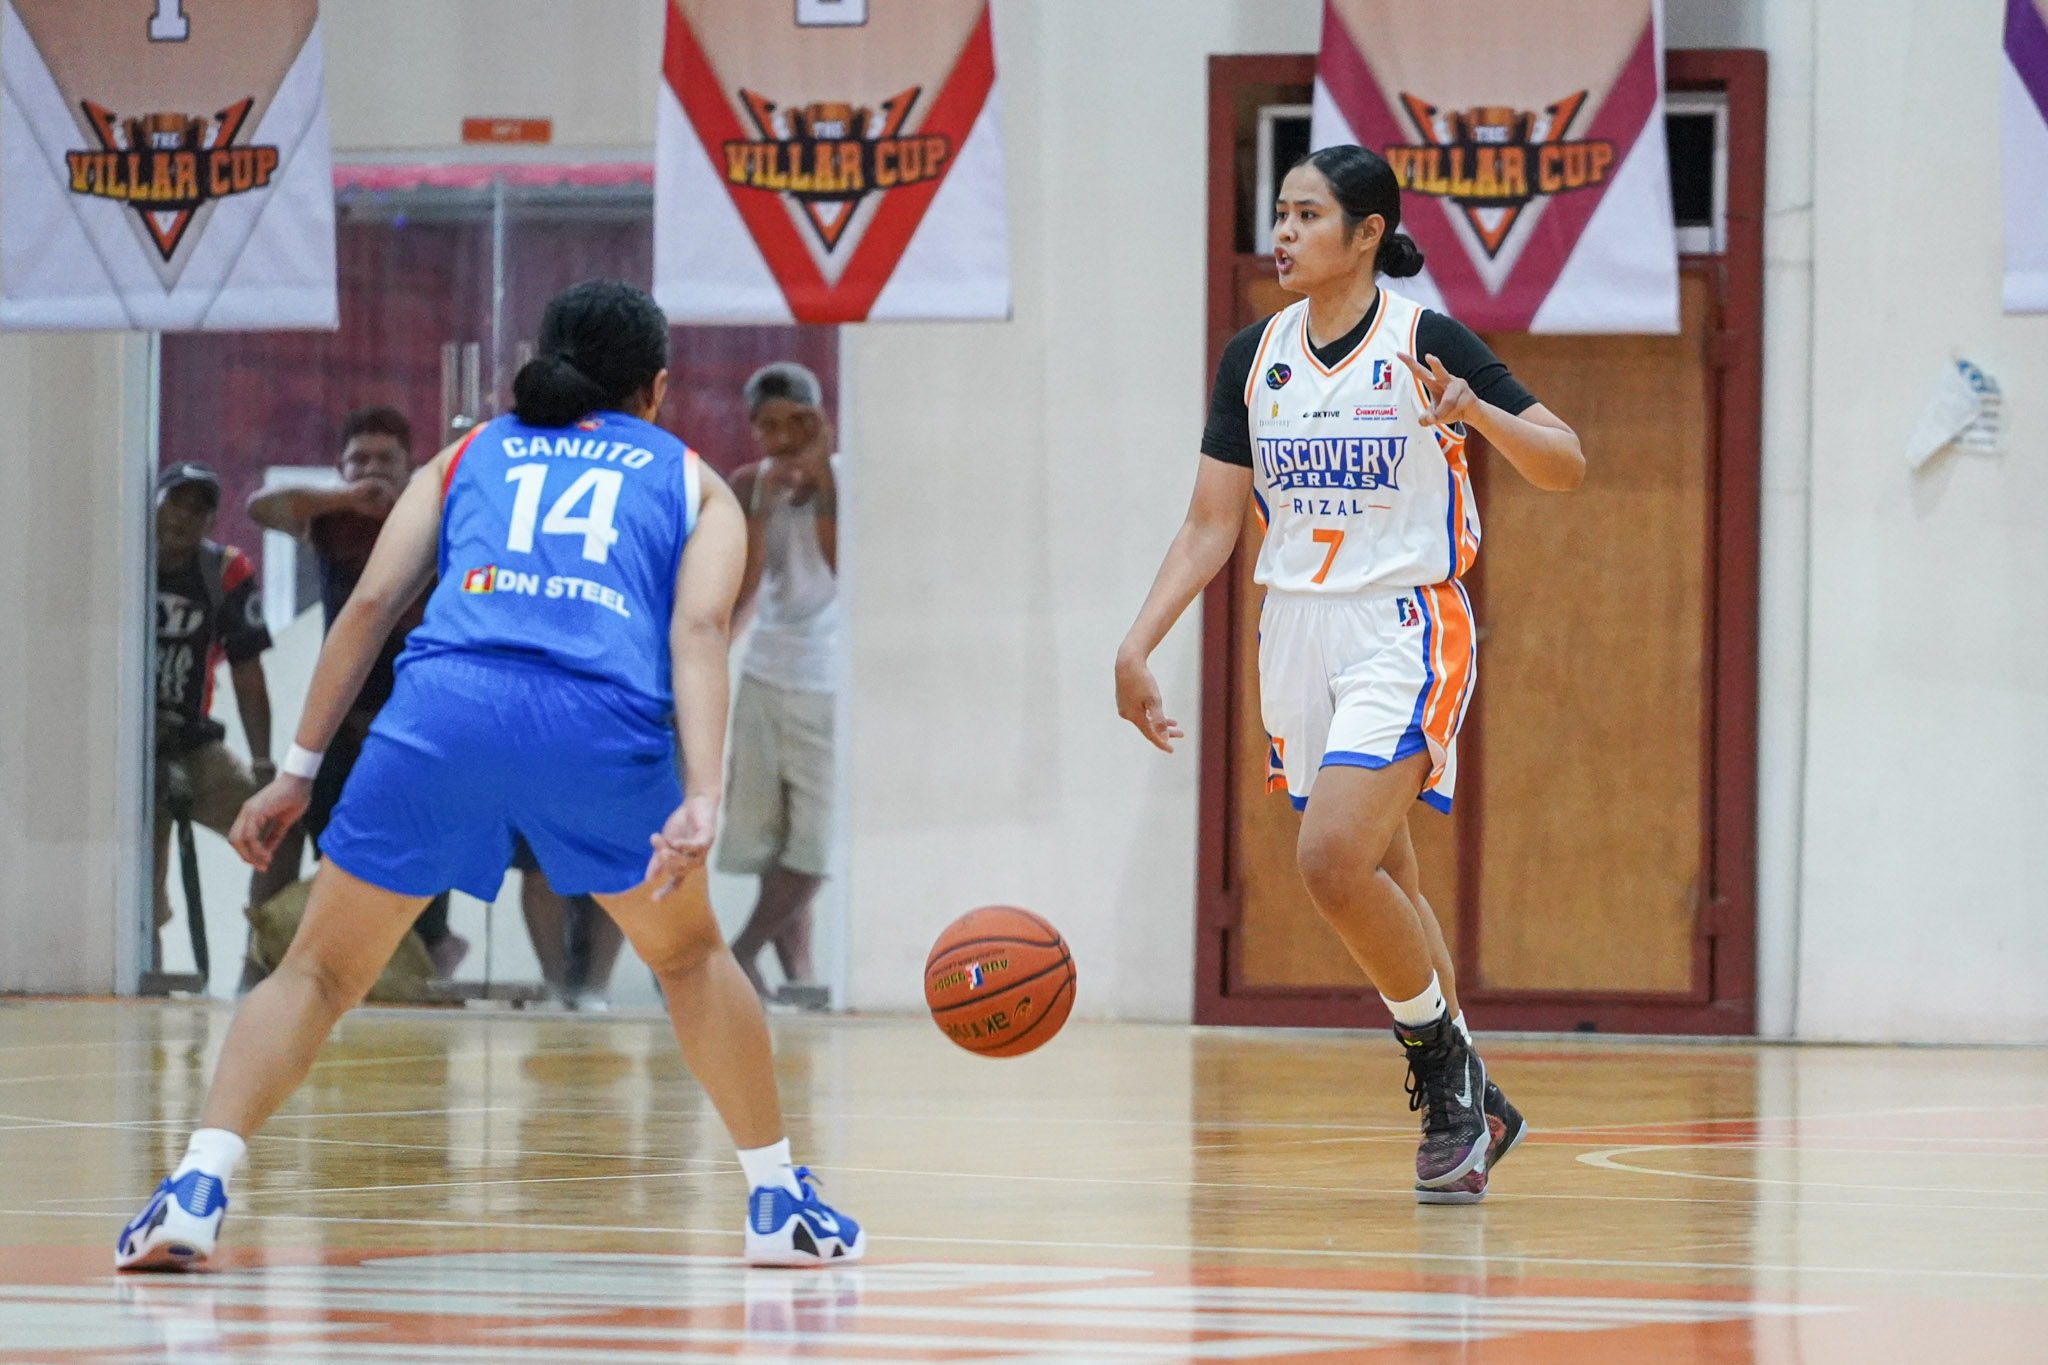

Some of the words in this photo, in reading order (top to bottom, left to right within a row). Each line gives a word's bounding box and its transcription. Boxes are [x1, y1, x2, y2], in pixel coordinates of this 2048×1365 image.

[68, 151, 198, 199] VILLAR
[209, 147, 278, 195] CUP
[723, 142, 864, 192] VILLAR
[874, 137, 947, 187] CUP
[1384, 147, 1528, 197] VILLAR
[1538, 142, 1613, 192] CUP
[501, 436, 655, 469] CANUTO
[1257, 438, 1406, 489] DISCOVERY
[1279, 472, 1376, 488] PERLAS
[504, 463, 624, 564] 14
[1294, 498, 1363, 516] RIZAL
[1310, 528, 1345, 584] 7
[496, 569, 540, 596] DN
[544, 575, 632, 618] STEEL
